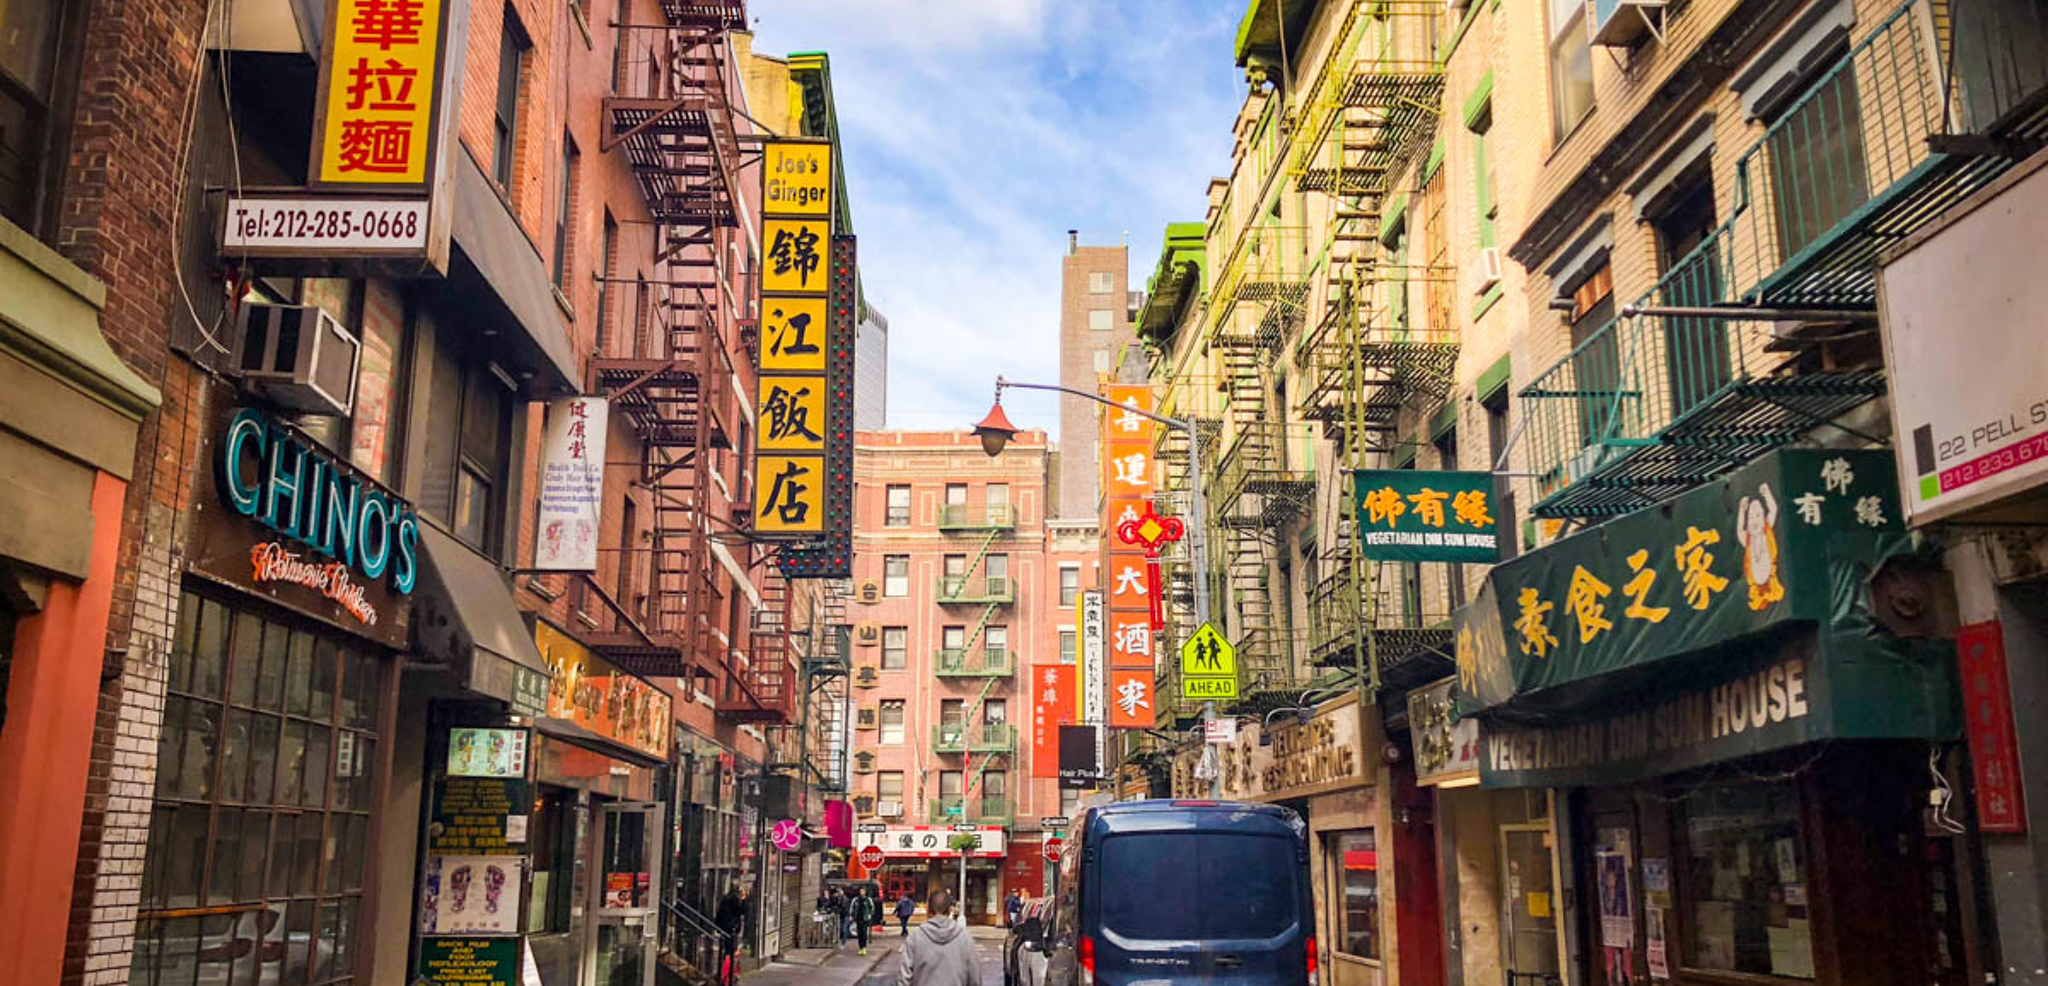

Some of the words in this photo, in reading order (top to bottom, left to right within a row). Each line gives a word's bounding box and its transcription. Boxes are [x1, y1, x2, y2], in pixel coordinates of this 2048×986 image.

[338, 0, 424, 173] 華拉麵
[775, 152, 819, 174] Joe's
[767, 179, 826, 206] Ginger
[236, 209, 270, 238] Tel:
[272, 209, 418, 239] 212-285-0668
[760, 225, 823, 525] 錦江飯店
[567, 401, 588, 458] 健康堂
[1938, 435, 1967, 462] 22
[1972, 414, 2025, 449] PELL
[2029, 396, 2048, 425] S
[225, 408, 418, 595] CHINO'S
[1362, 486, 1496, 529] 佛有緣
[1365, 531, 1424, 545] VEGETARIAN
[1425, 532, 1443, 545] DIM
[1444, 533, 1465, 546] SUM
[1466, 534, 1498, 548] HOUSE
[1513, 526, 1730, 658] 素食之家
[1189, 681, 1231, 694] AHEAD
[1488, 721, 1599, 772] VEGETARIAN
[1610, 711, 1649, 761] DIM
[1711, 659, 1808, 739] HOUSE
[1059, 769, 1076, 777] Hair
[1077, 769, 1094, 777] Plus
[861, 853, 882, 862] STOP
